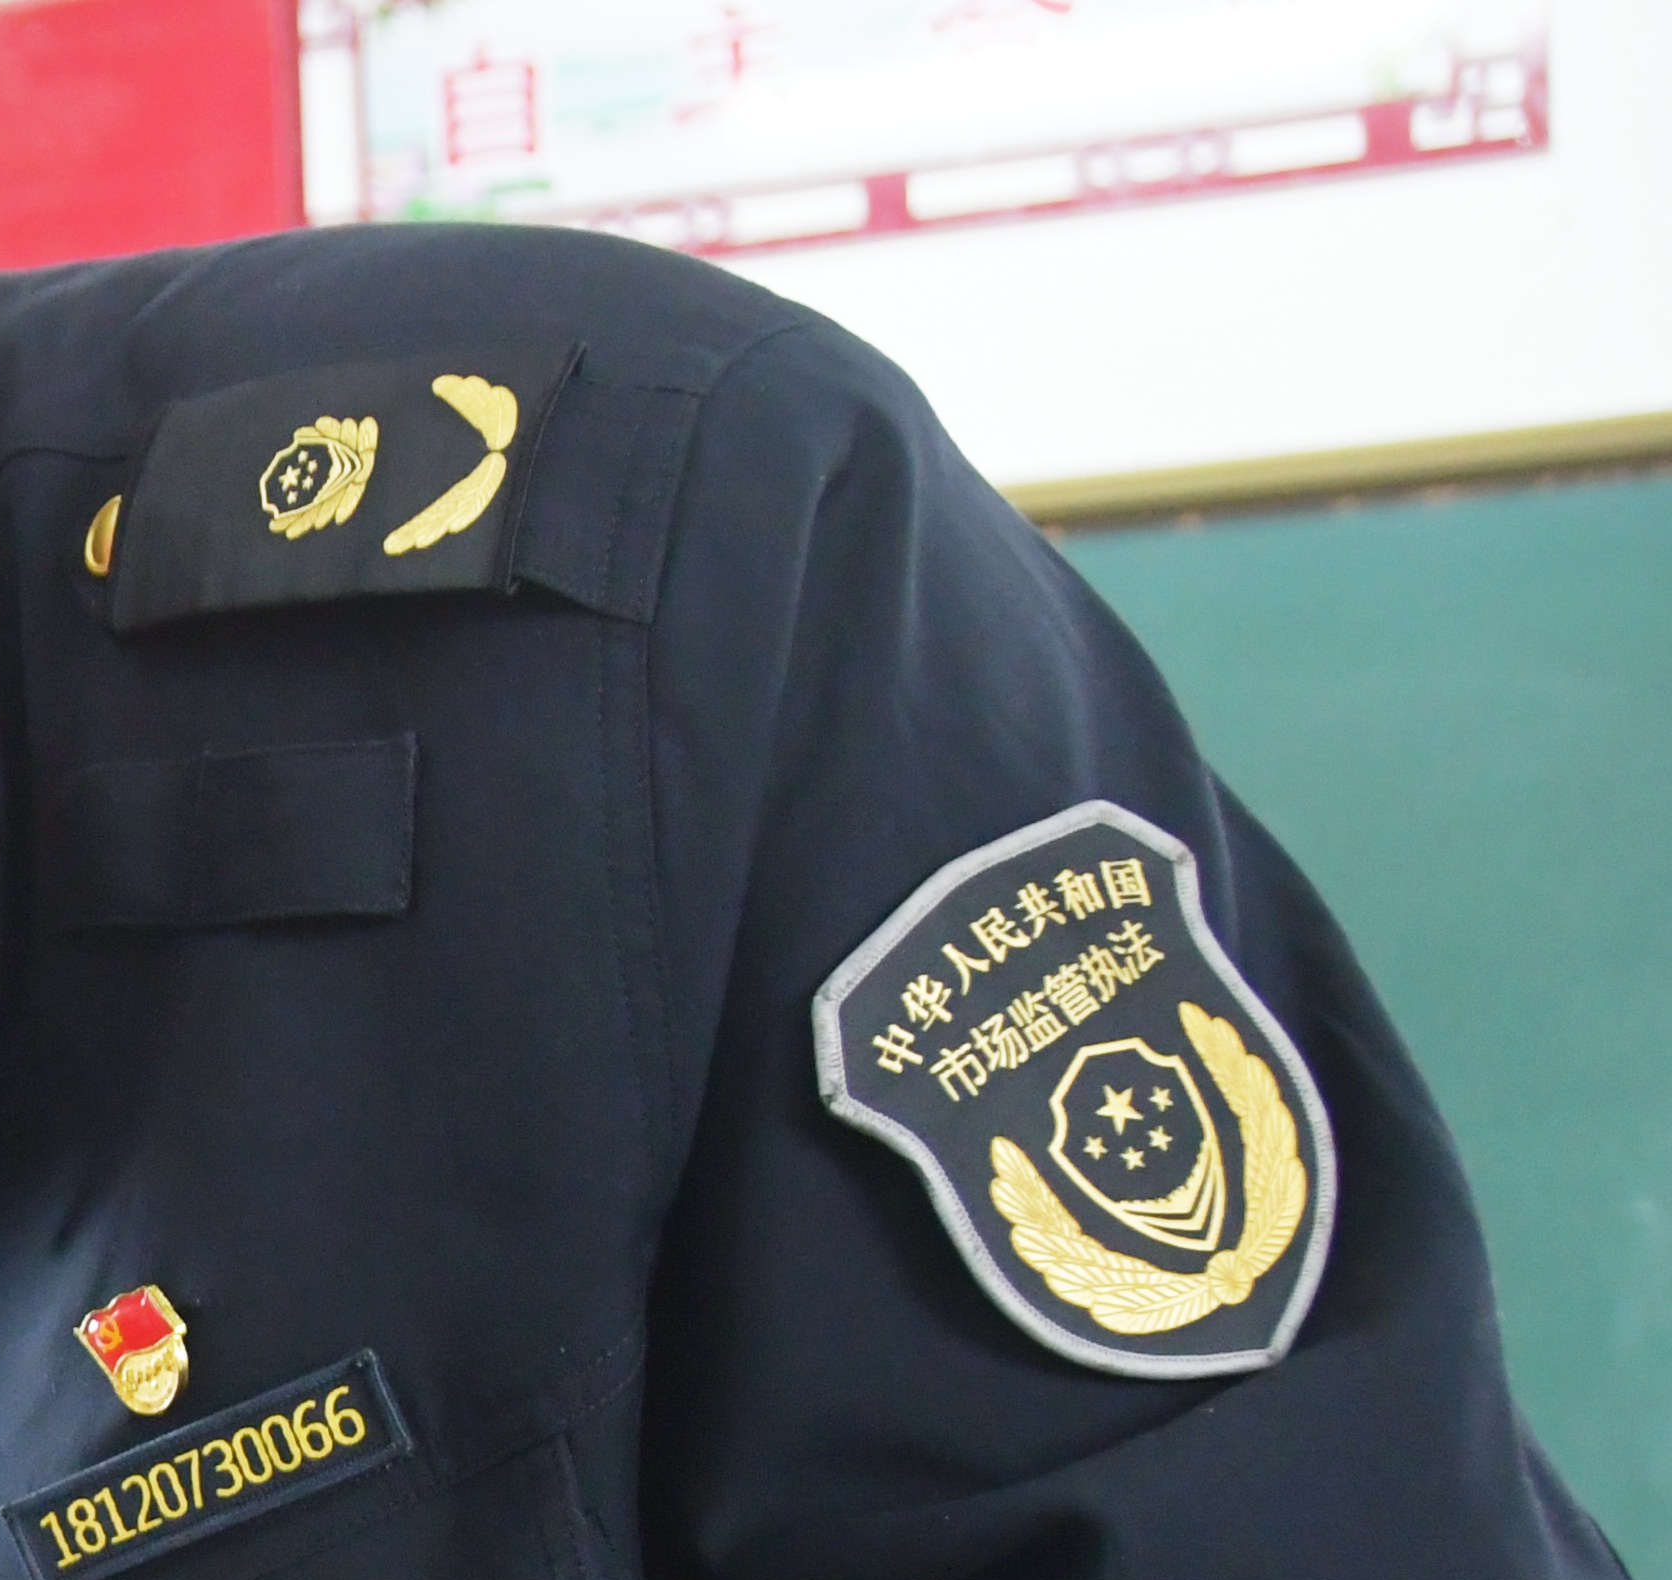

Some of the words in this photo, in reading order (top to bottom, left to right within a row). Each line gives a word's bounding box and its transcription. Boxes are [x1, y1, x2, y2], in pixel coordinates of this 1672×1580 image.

[871, 857, 1153, 1074] 中华人民共和国
[929, 920, 1165, 1103] 市场监管执法
[39, 1384, 367, 1568] 18120730066
